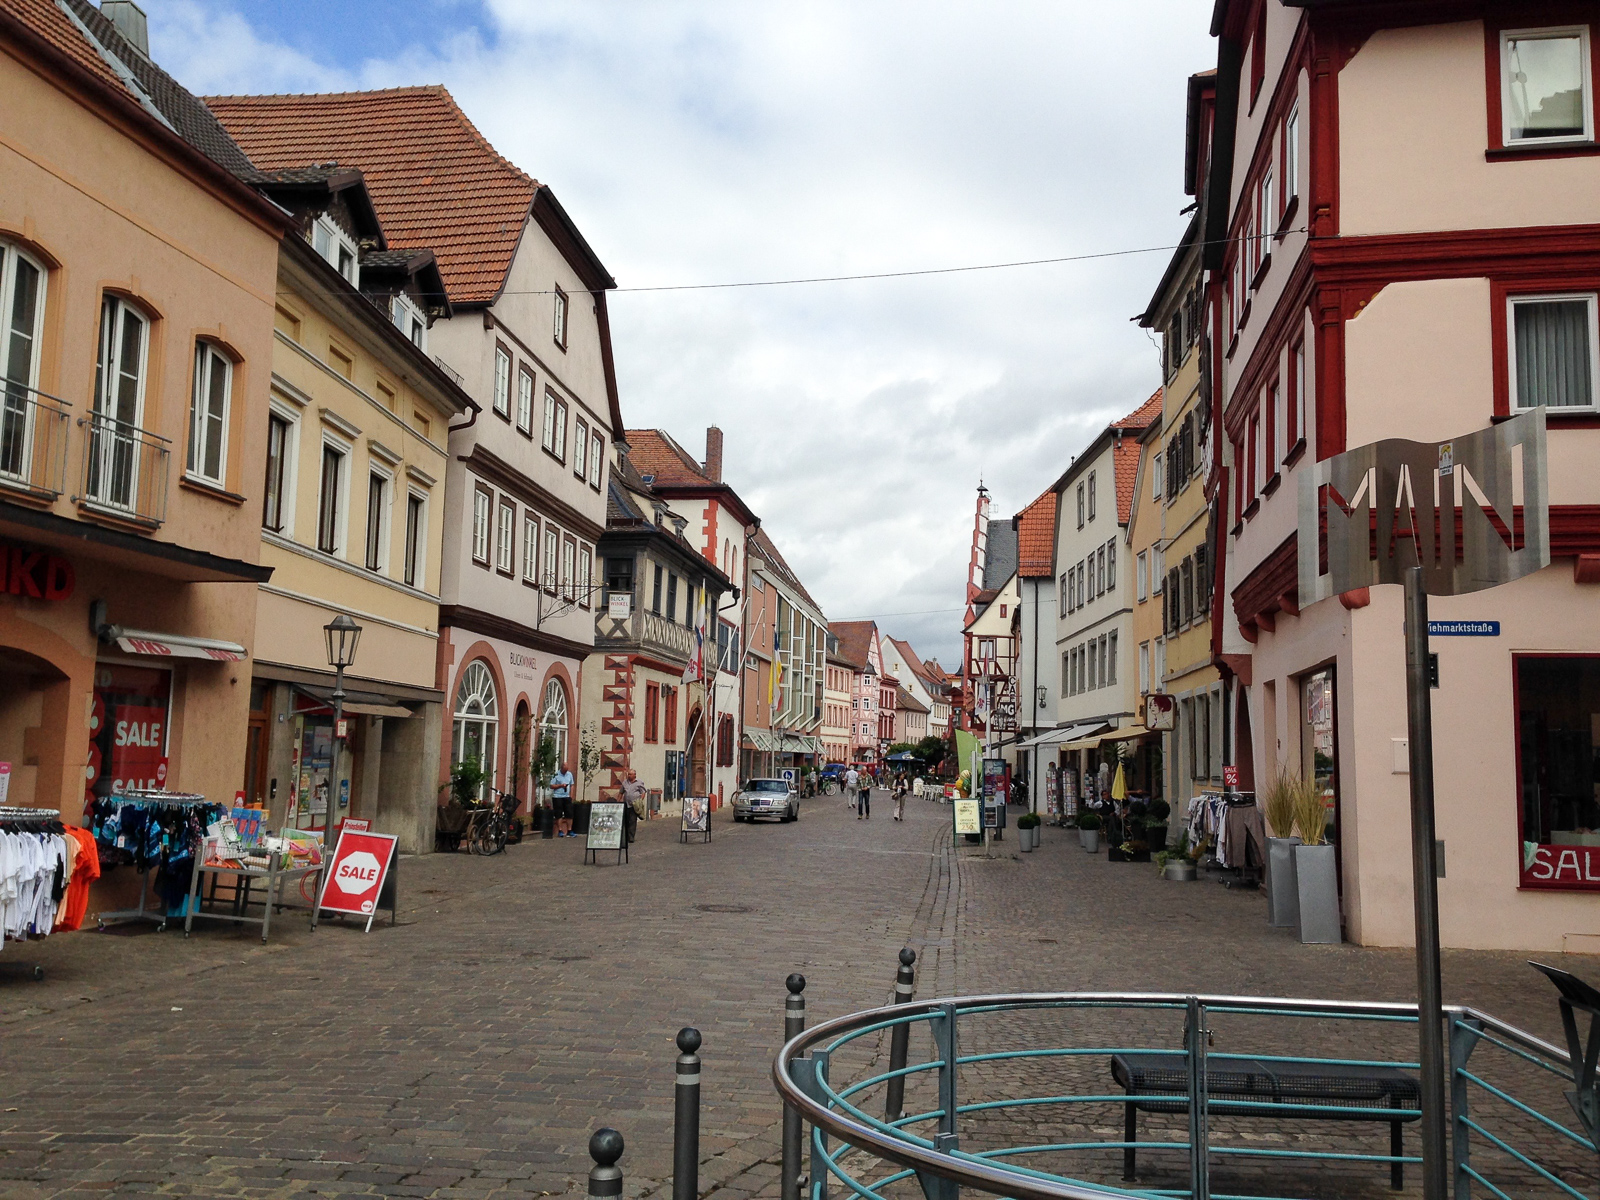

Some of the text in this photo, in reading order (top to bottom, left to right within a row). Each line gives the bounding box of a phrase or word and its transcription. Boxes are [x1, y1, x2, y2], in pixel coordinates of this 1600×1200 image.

[1318, 442, 1525, 577] MAIN
[1428, 622, 1493, 633] iehmarktstraße
[128, 638, 172, 655] NKD
[510, 652, 537, 670] BLICKWINKEL
[115, 720, 161, 747] SALE
[340, 865, 377, 881] SALE
